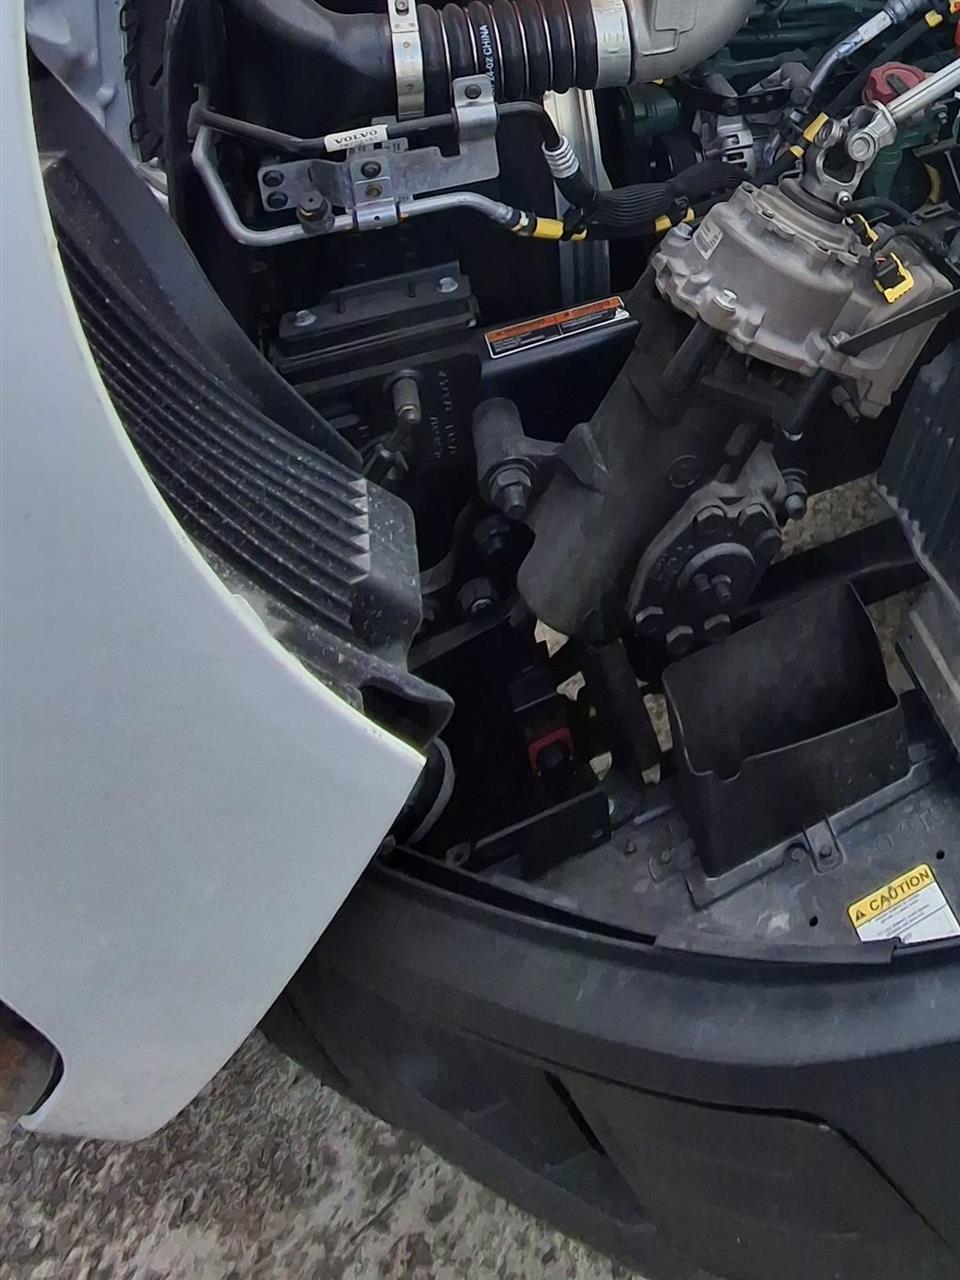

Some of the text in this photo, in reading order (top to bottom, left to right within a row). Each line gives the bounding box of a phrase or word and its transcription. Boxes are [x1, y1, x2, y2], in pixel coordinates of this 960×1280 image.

[479, 24, 493, 56] CHINA
[334, 129, 378, 145] VOLVO
[869, 869, 930, 912] CAUTION
